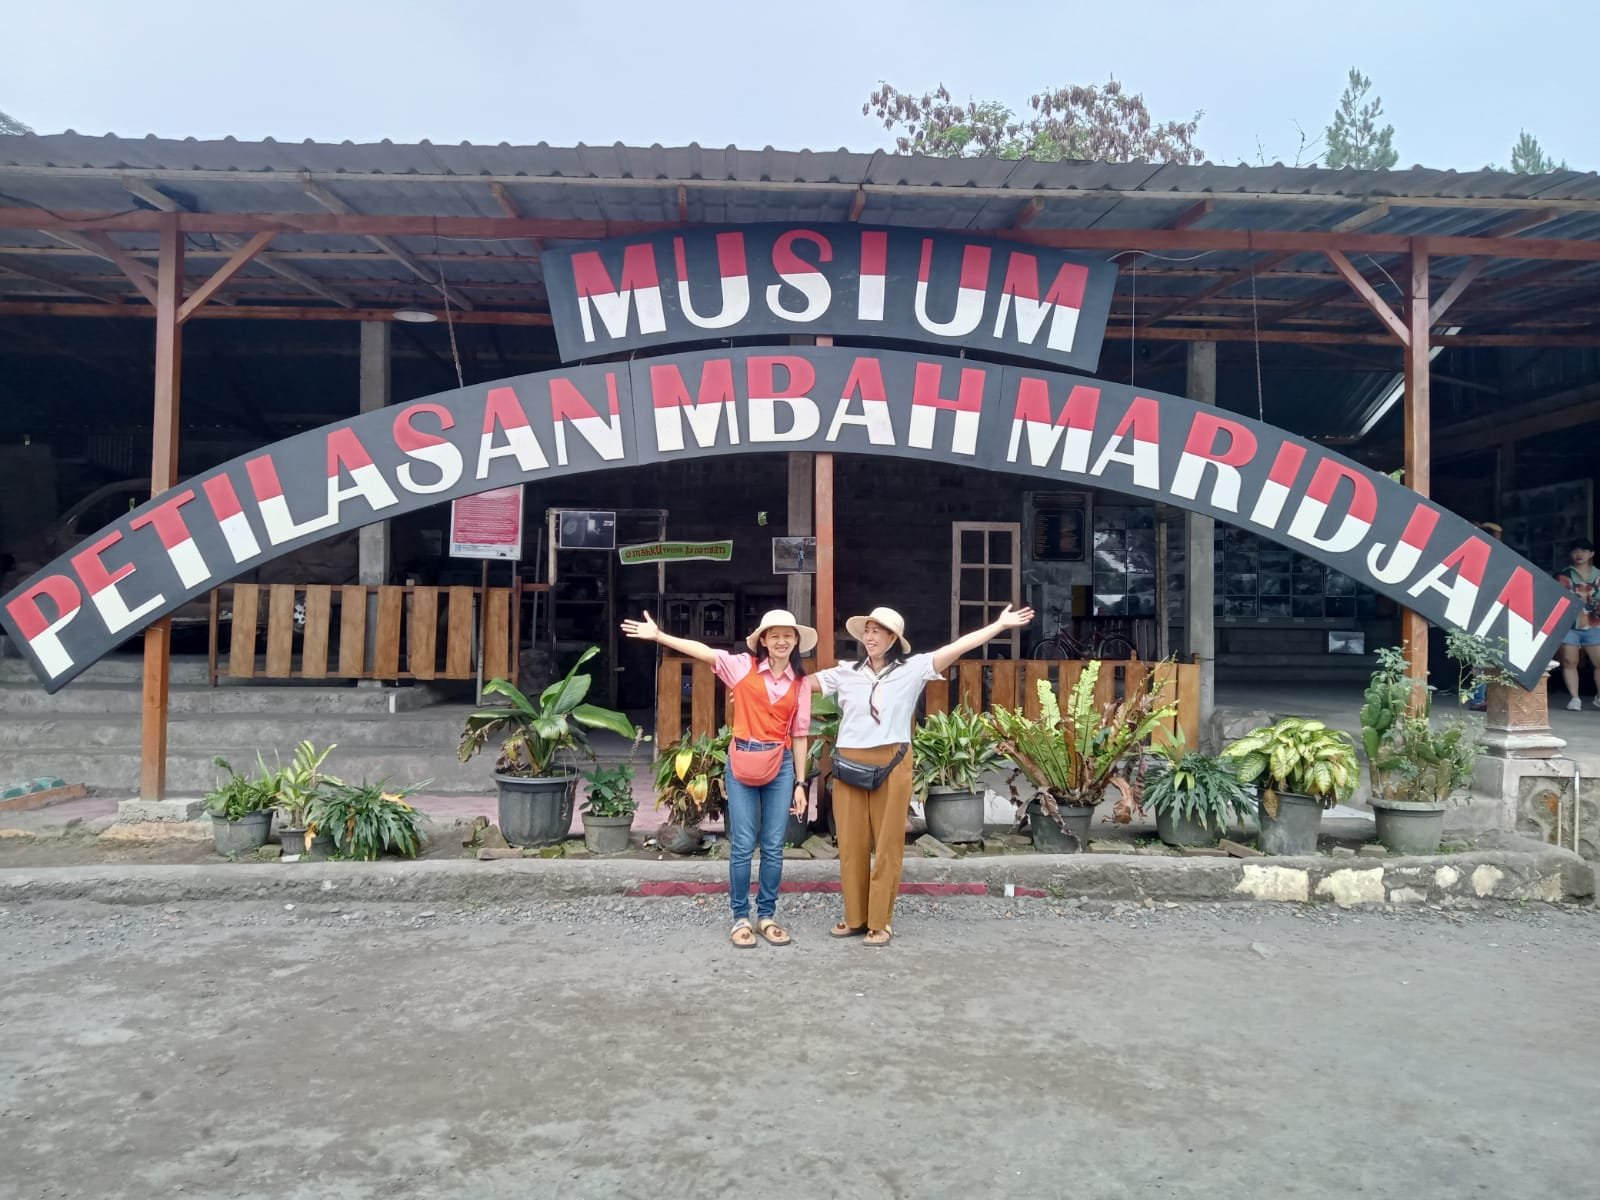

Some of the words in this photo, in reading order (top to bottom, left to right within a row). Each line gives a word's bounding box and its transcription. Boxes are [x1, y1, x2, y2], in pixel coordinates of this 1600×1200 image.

[572, 229, 1089, 352] MUSIUM
[6, 372, 625, 680] PETILASAN
[650, 355, 986, 456] MBAH
[1007, 377, 1570, 672] MARIDJAN
